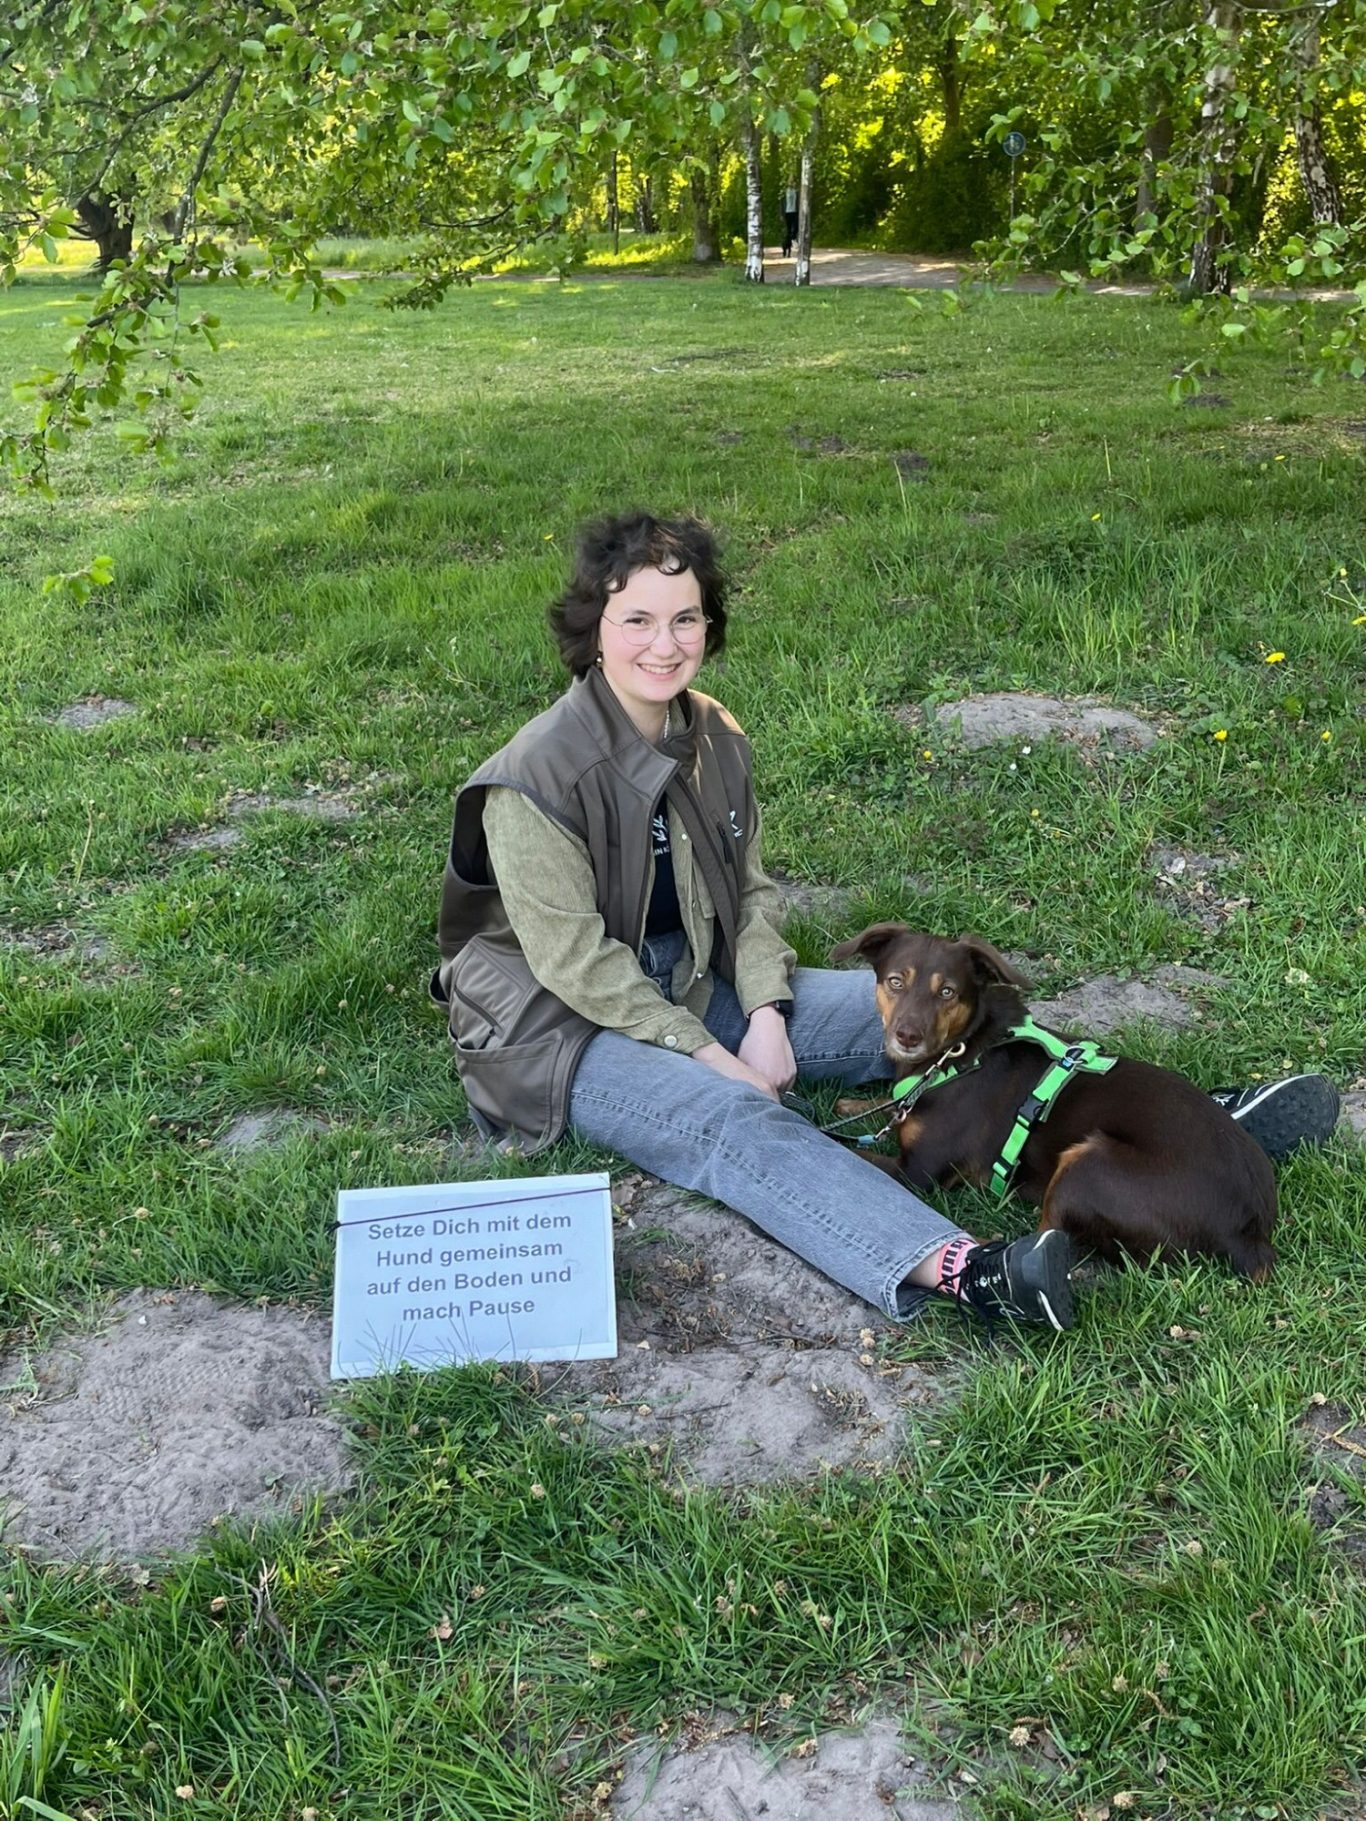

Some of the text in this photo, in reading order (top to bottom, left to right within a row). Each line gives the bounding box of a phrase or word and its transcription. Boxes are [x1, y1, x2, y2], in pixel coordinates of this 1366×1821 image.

[368, 1213, 572, 1240] Setze Dich mit dem
[377, 1243, 563, 1267] Hund gemeinsam
[367, 1266, 572, 1296] auf den Boden und
[402, 1299, 535, 1321] mach Pause
